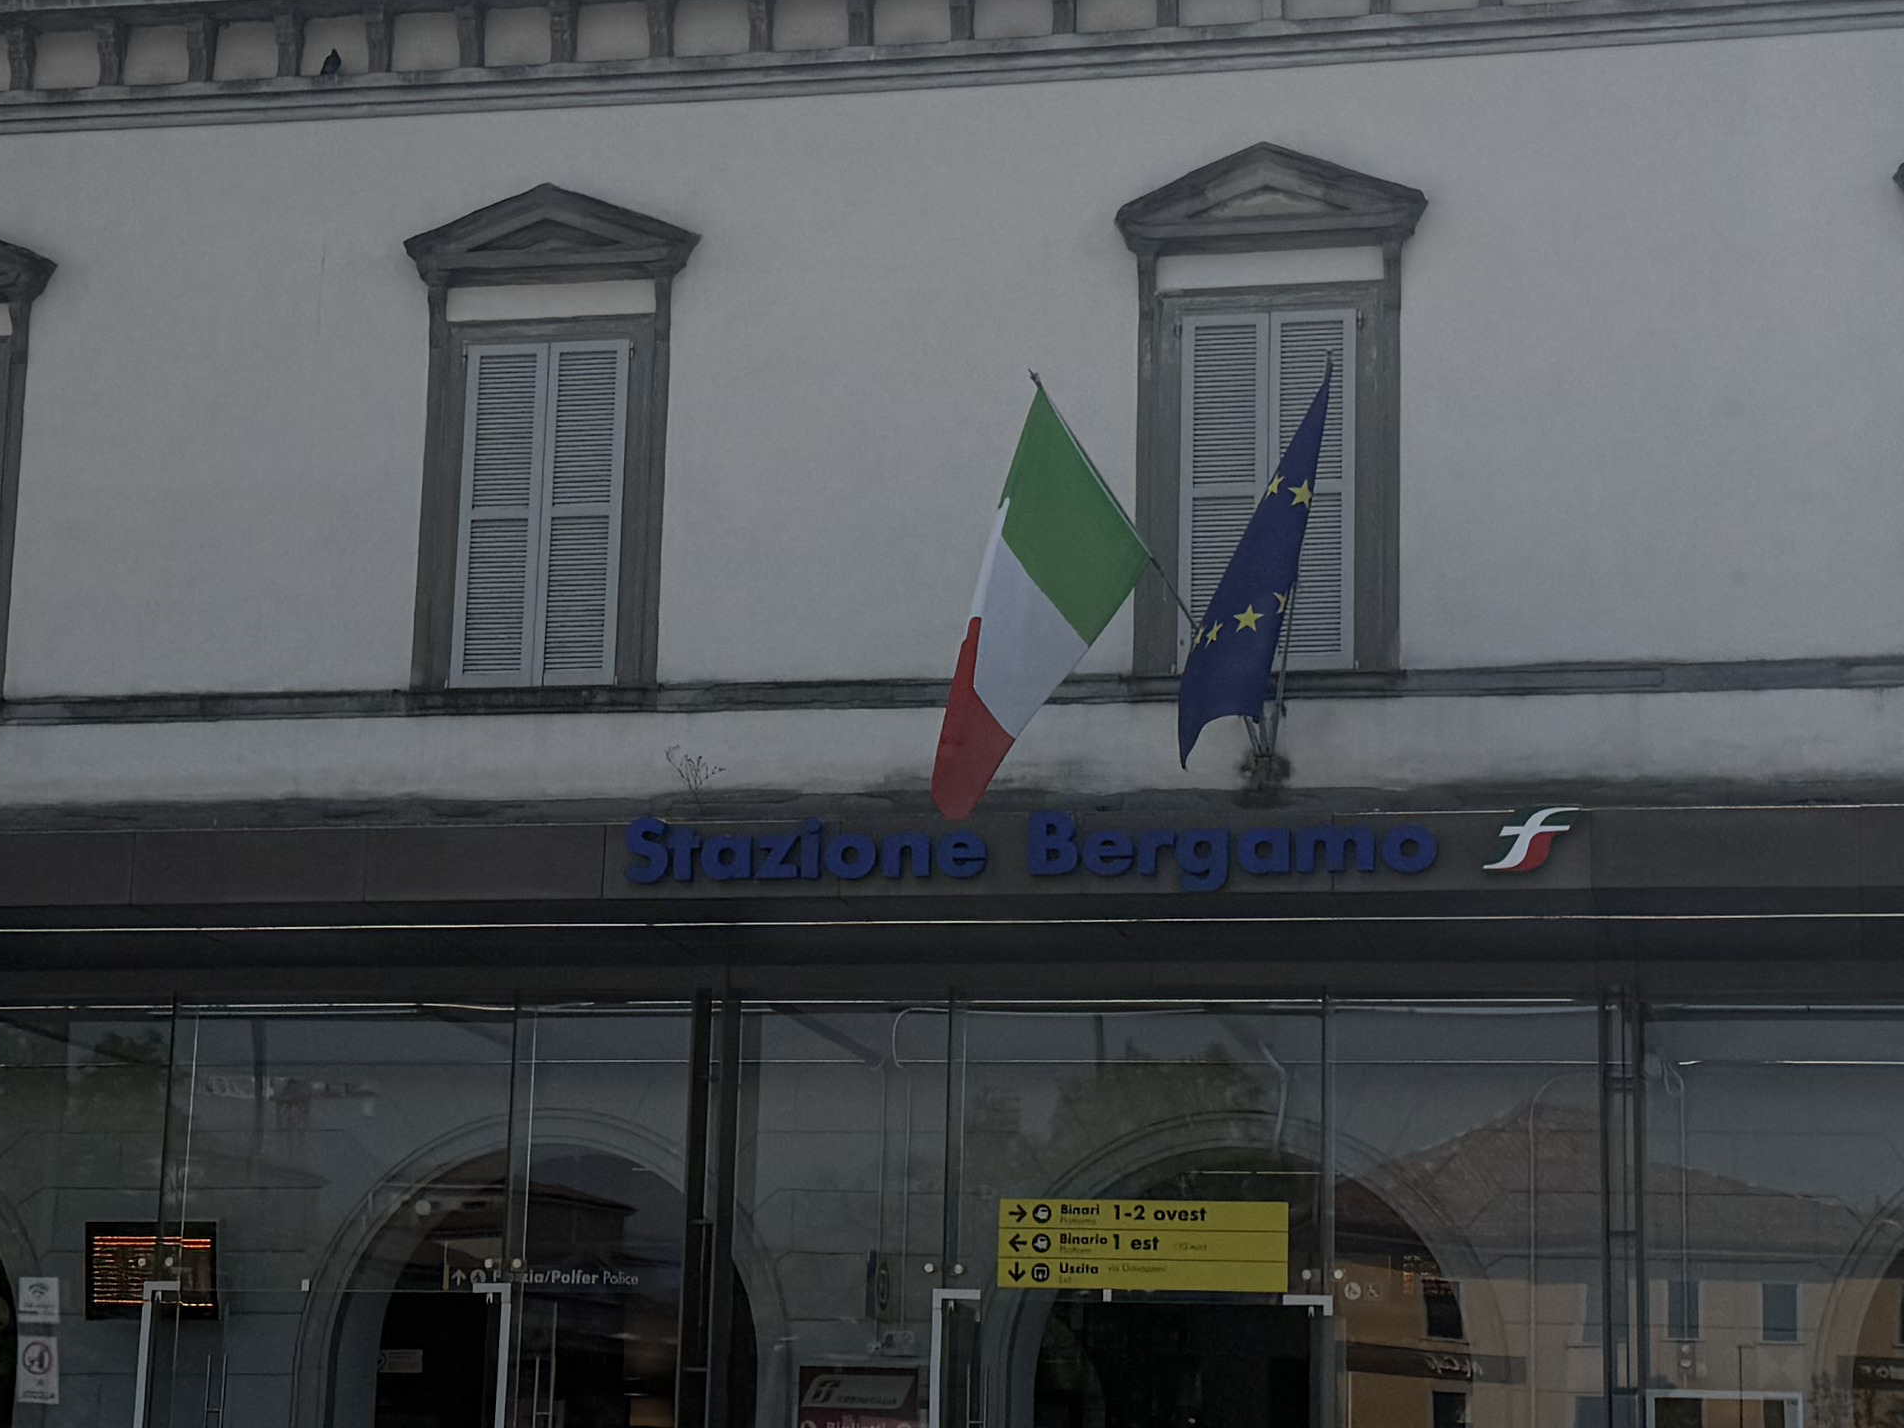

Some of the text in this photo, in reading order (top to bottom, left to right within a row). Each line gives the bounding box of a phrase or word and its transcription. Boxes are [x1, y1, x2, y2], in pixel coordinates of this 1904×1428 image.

[624, 809, 1439, 892] Stazione Bergamo
[1060, 1204, 1207, 1222] Binari 1-2 ovest
[1059, 1233, 1108, 1245] Binario
[1113, 1234, 1120, 1250] 1
[1130, 1236, 1160, 1251] est
[493, 1268, 639, 1285] Pzia/Polfer Police
[1059, 1262, 1099, 1274] Uscita
